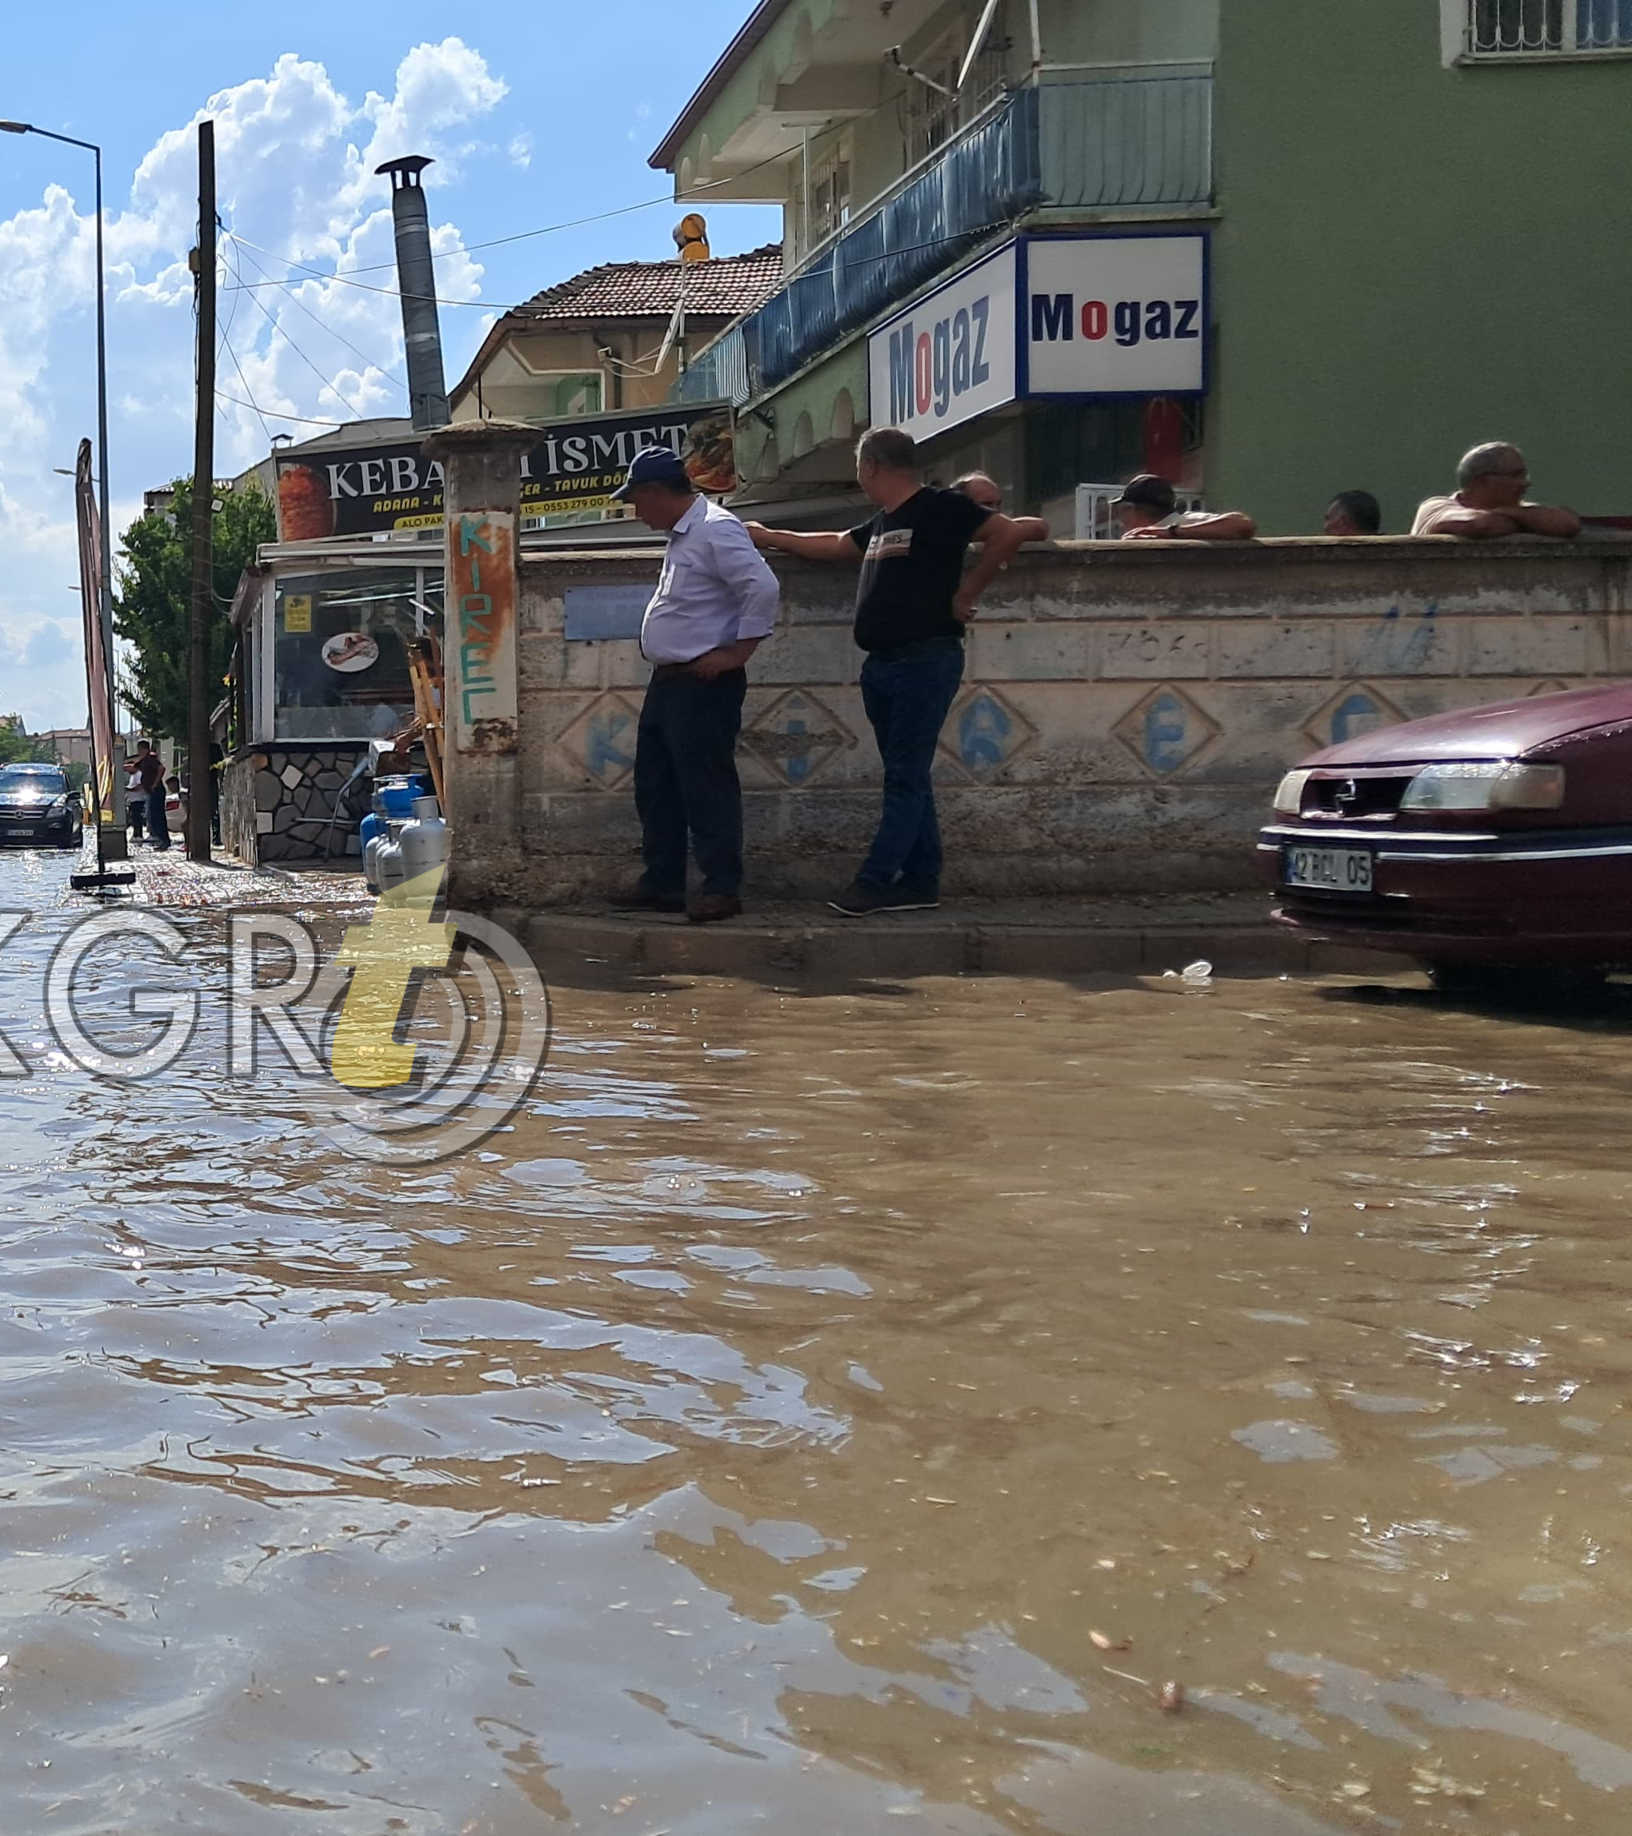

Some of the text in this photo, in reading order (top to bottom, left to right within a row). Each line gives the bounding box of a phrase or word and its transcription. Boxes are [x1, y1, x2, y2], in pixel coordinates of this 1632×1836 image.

[1032, 294, 1200, 346] Mogaz
[889, 296, 990, 425] Mogaz
[373, 496, 420, 513] ADANA
[555, 475, 601, 493] TAVUK
[402, 518, 423, 528] ALO
[1347, 855, 1370, 885] 05
